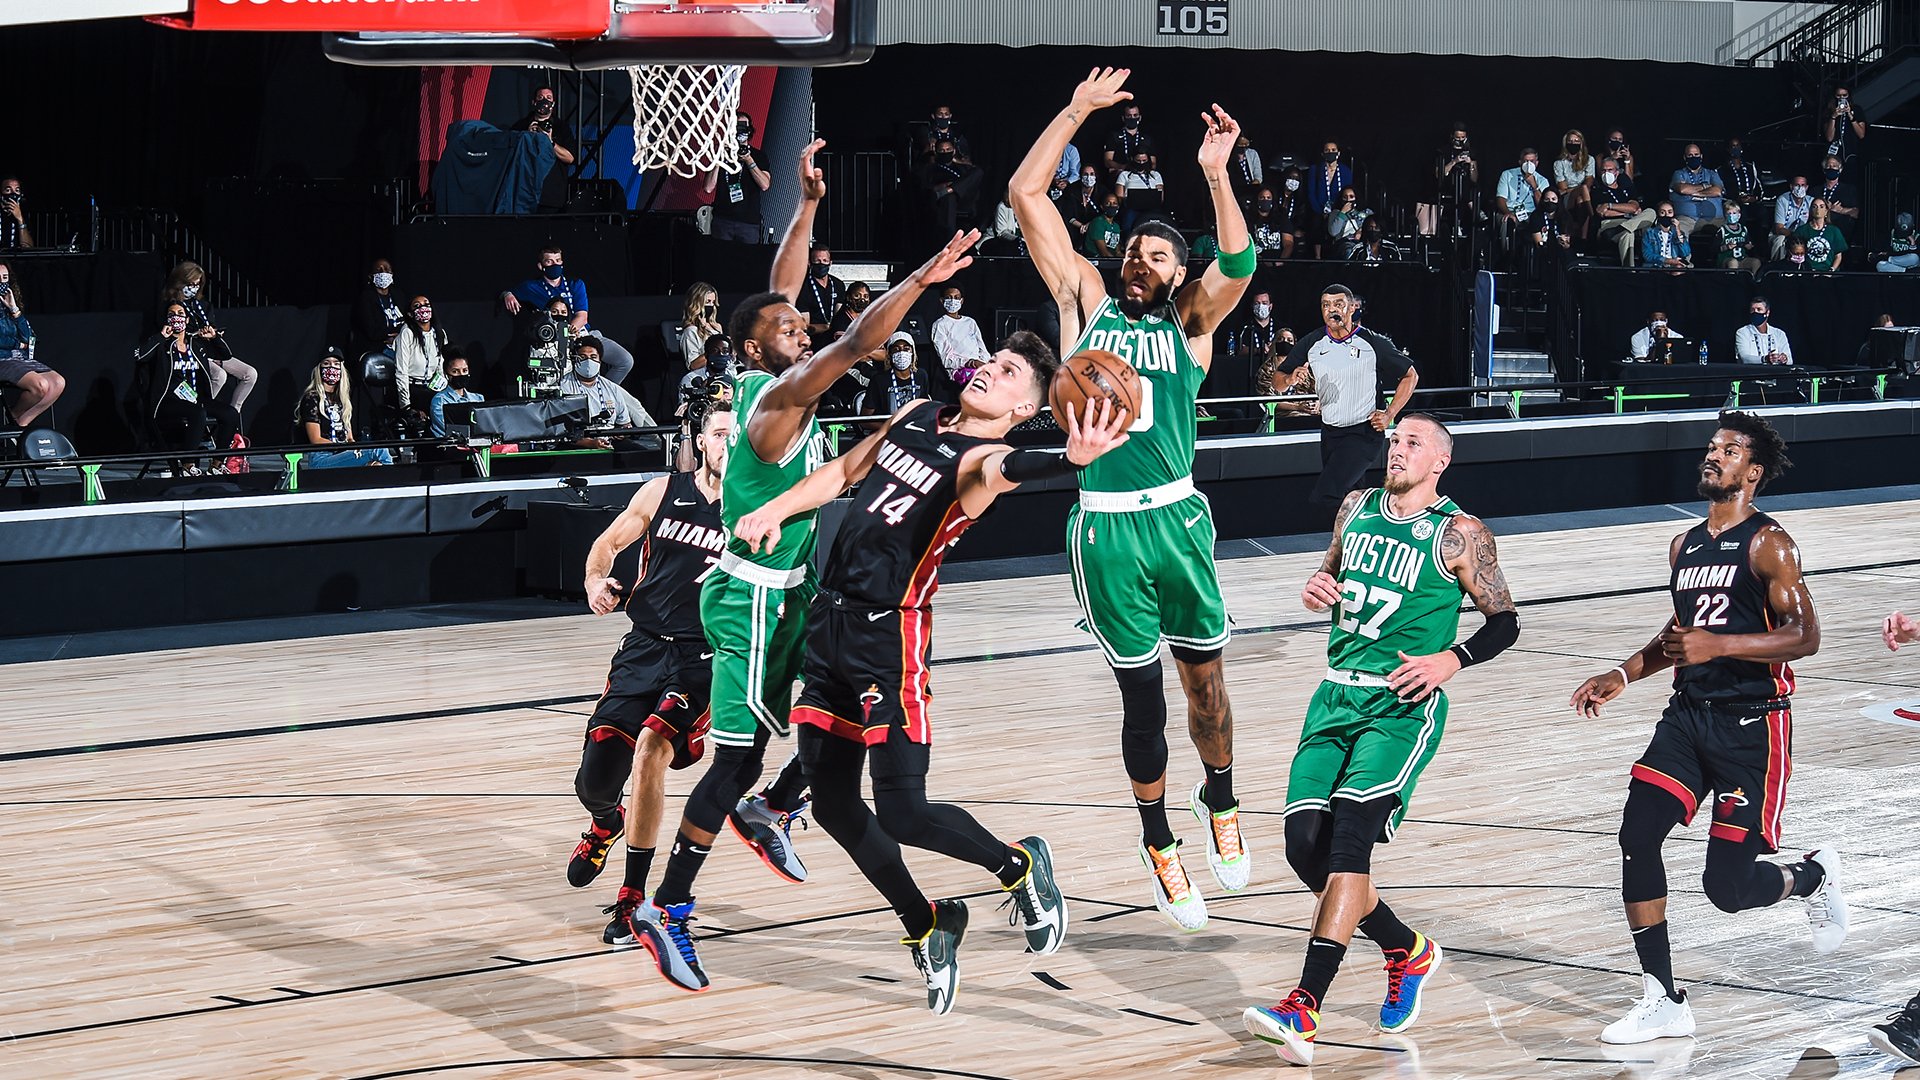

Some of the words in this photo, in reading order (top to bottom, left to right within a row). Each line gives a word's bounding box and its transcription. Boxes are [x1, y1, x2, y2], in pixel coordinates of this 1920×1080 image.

[1159, 5, 1227, 34] 105
[1088, 329, 1177, 375] BOSTON
[1081, 361, 1131, 414] PALNG
[876, 439, 943, 495] MIAMI
[866, 483, 918, 526] 14
[655, 517, 727, 553] MIAM
[693, 555, 722, 584] 7
[1340, 531, 1427, 593] BOSTON
[1675, 565, 1738, 592] MIAMI
[1337, 578, 1404, 641] 27
[1692, 593, 1730, 627] 22
